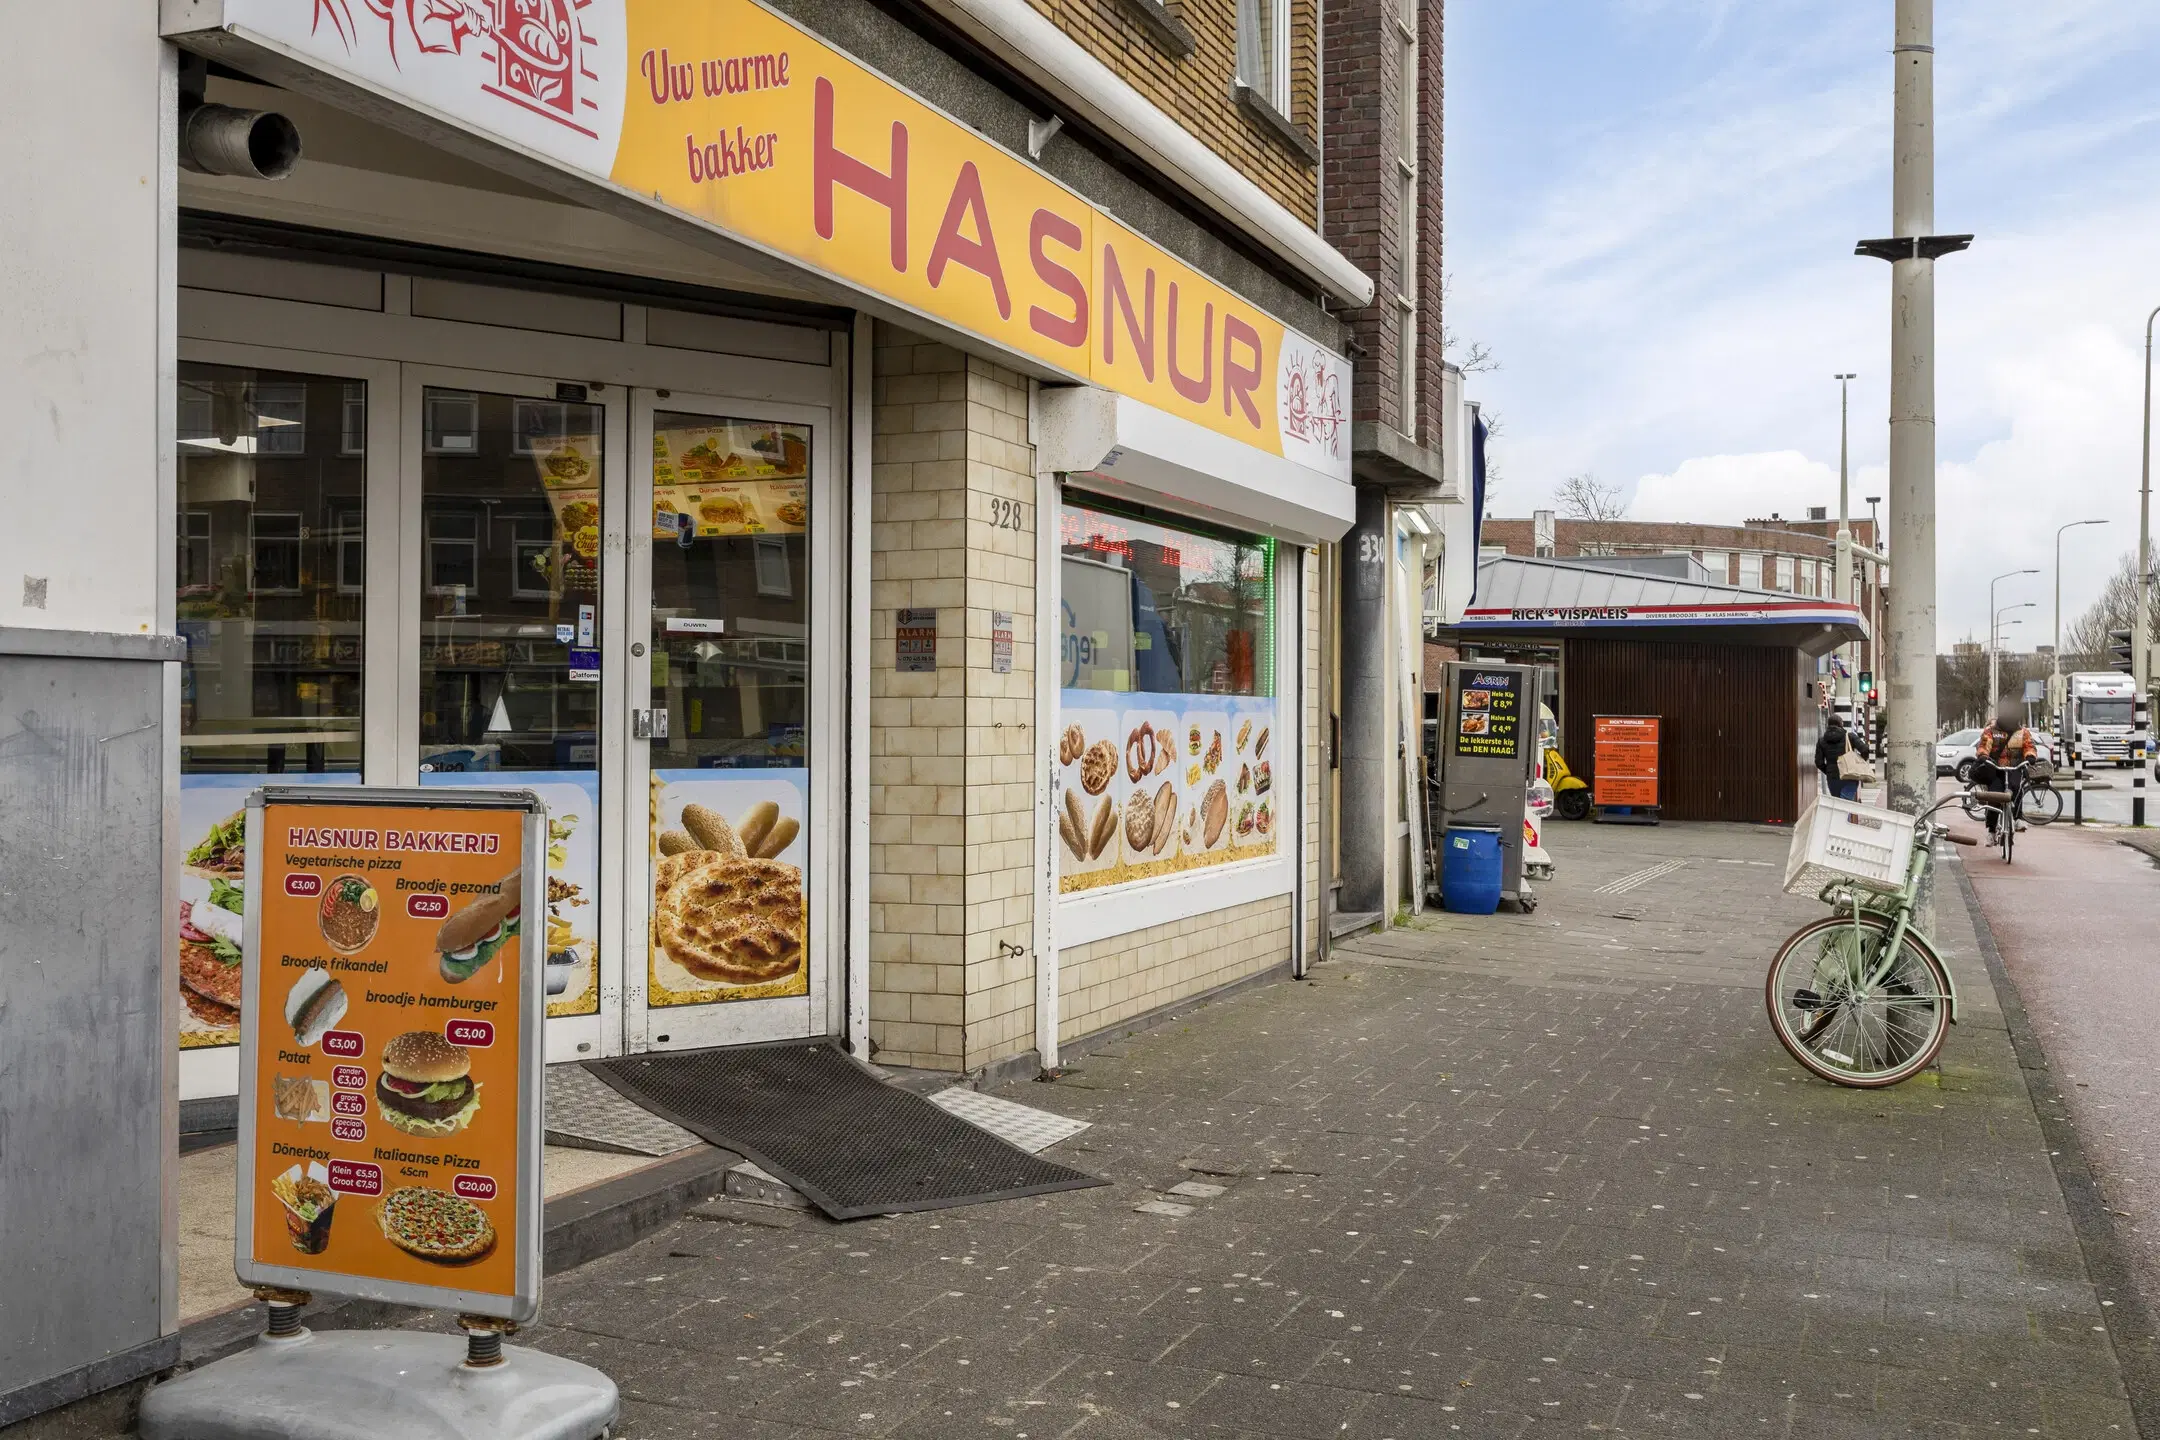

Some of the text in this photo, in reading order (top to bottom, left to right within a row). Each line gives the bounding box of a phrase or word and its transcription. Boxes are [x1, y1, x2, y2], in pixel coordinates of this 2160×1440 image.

[640, 48, 790, 105] Uw warme
[685, 125, 778, 184] bakker
[812, 75, 1263, 430] HASNUR
[988, 497, 1021, 531] 328
[1359, 534, 1385, 563] 330
[1510, 608, 1629, 621] RICK'S VISPALEIS
[898, 629, 935, 638] ALARM
[993, 631, 1013, 640] ALARM
[570, 671, 599, 679] Platform
[1504, 691, 1515, 699] Kip
[1493, 699, 1499, 707] €
[1506, 715, 1517, 723] Kip
[1492, 724, 1497, 732] €
[1460, 736, 1515, 747] De lekkerste kip
[1472, 745, 1489, 753] DEN
[287, 826, 500, 855] HASNUR BAKKERIJ
[285, 853, 402, 871] Vegetarische pizza
[290, 880, 316, 890] €3,00
[395, 877, 502, 896] Broodje gezond
[414, 901, 442, 912] €2,50
[281, 954, 389, 974] Broodje frikandel
[365, 989, 498, 1013] broodje hamburger
[454, 1027, 487, 1040] €3,00
[328, 1038, 358, 1051] €3,00
[278, 1049, 312, 1065] Patat
[339, 1067, 362, 1076] zonder
[337, 1075, 364, 1088] €3,00
[340, 1094, 359, 1102] groot
[335, 1102, 363, 1113] €3,50
[335, 1119, 363, 1128] speciaal
[335, 1127, 364, 1139] €4,00
[271, 1142, 331, 1161] Dönerbox
[373, 1147, 481, 1170] Italiaanse Pizza
[331, 1165, 379, 1179] Klein €5,50
[399, 1166, 429, 1179] 45cm
[331, 1176, 379, 1190] Groot €7,50
[457, 1180, 494, 1193] €20,00
